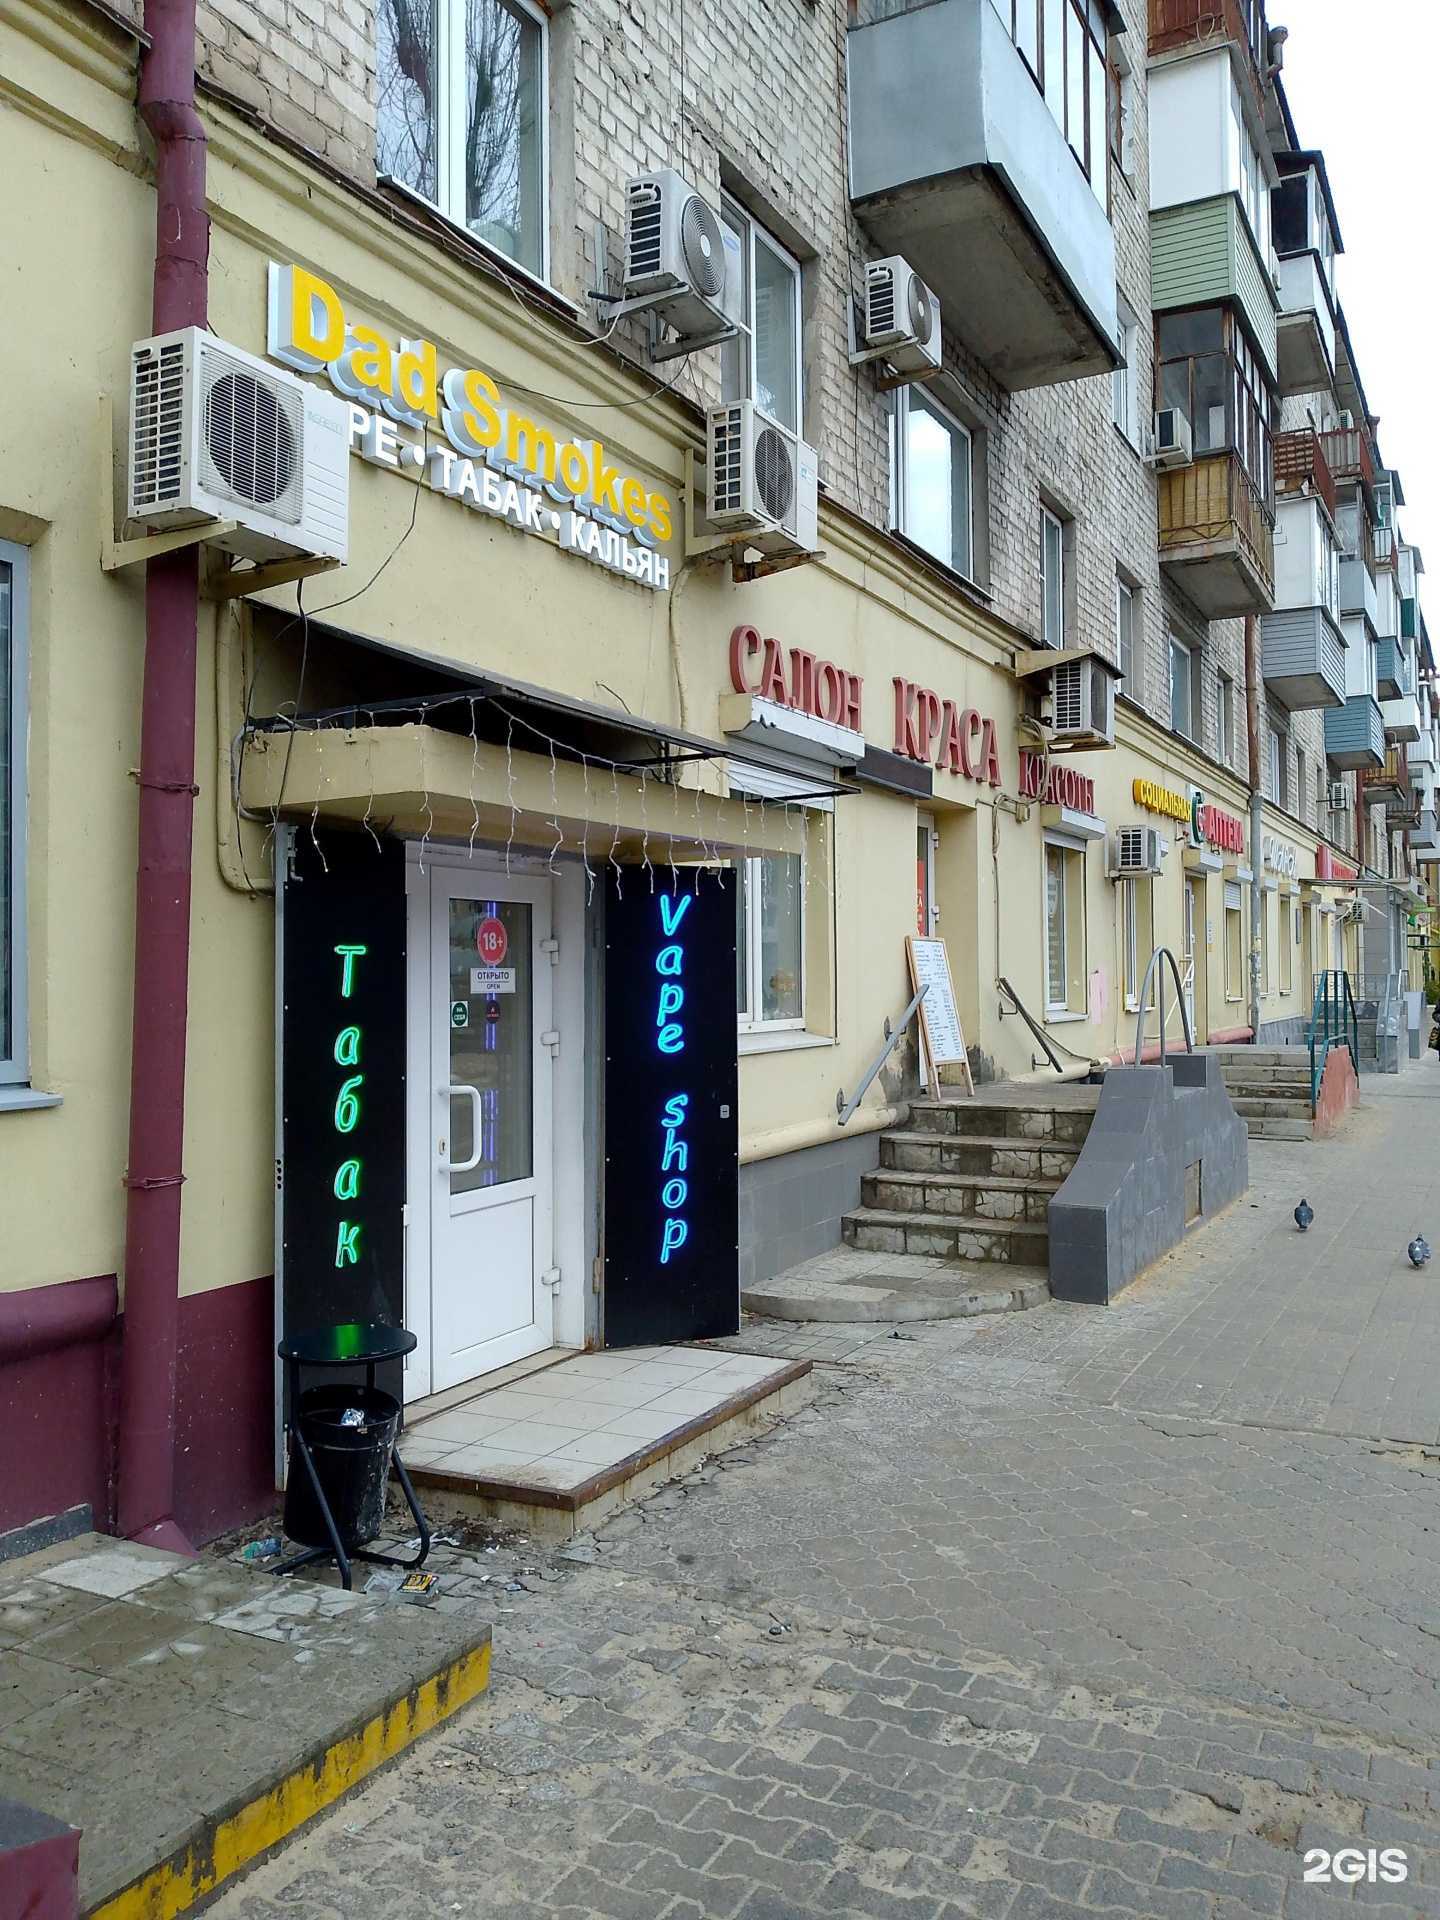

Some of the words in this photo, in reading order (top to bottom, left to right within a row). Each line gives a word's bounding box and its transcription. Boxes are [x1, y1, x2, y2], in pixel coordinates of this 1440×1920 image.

[268, 262, 438, 428] Dad
[443, 368, 673, 548] Smokes
[427, 445, 543, 533] ТАБАК
[559, 510, 670, 592] КАЛЬЯН
[730, 624, 864, 734] САЛОН
[892, 676, 1001, 787] КРАСА
[1018, 750, 1095, 815] КРАСОТЫ
[1133, 778, 1191, 823] СОЦИАЛЬНАЯ
[1205, 804, 1244, 854] АПТЕКА
[477, 971, 510, 980] ОТКРЫТО
[482, 931, 503, 951] 18+
[655, 894, 691, 1053] Vape
[334, 944, 367, 1268] Табак
[661, 1093, 689, 1264] shop
